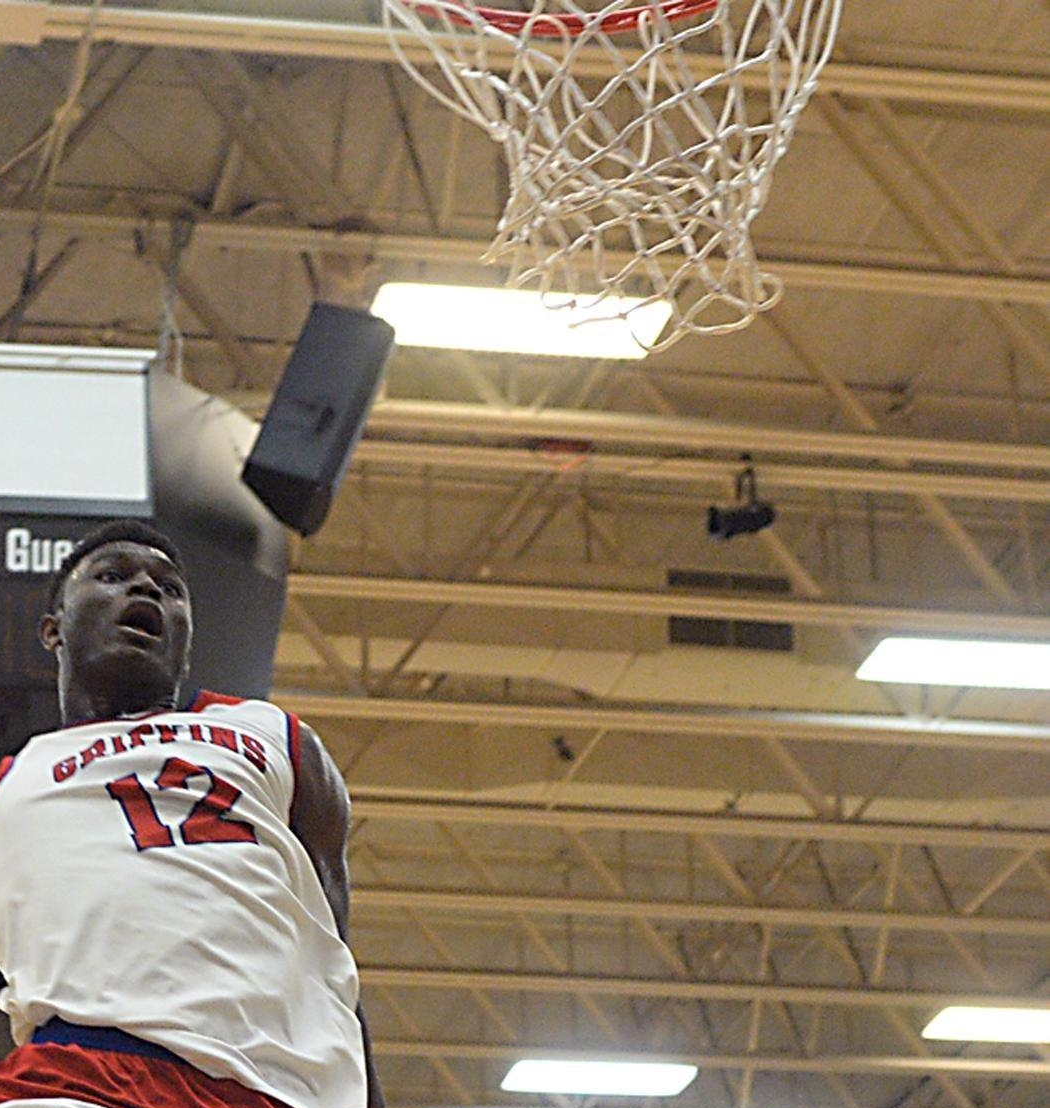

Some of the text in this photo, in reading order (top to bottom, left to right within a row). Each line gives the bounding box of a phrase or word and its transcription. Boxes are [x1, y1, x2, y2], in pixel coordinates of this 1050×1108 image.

[5, 528, 74, 572] Gue
[52, 724, 267, 784] GRIFFINS
[105, 757, 259, 851] 12
